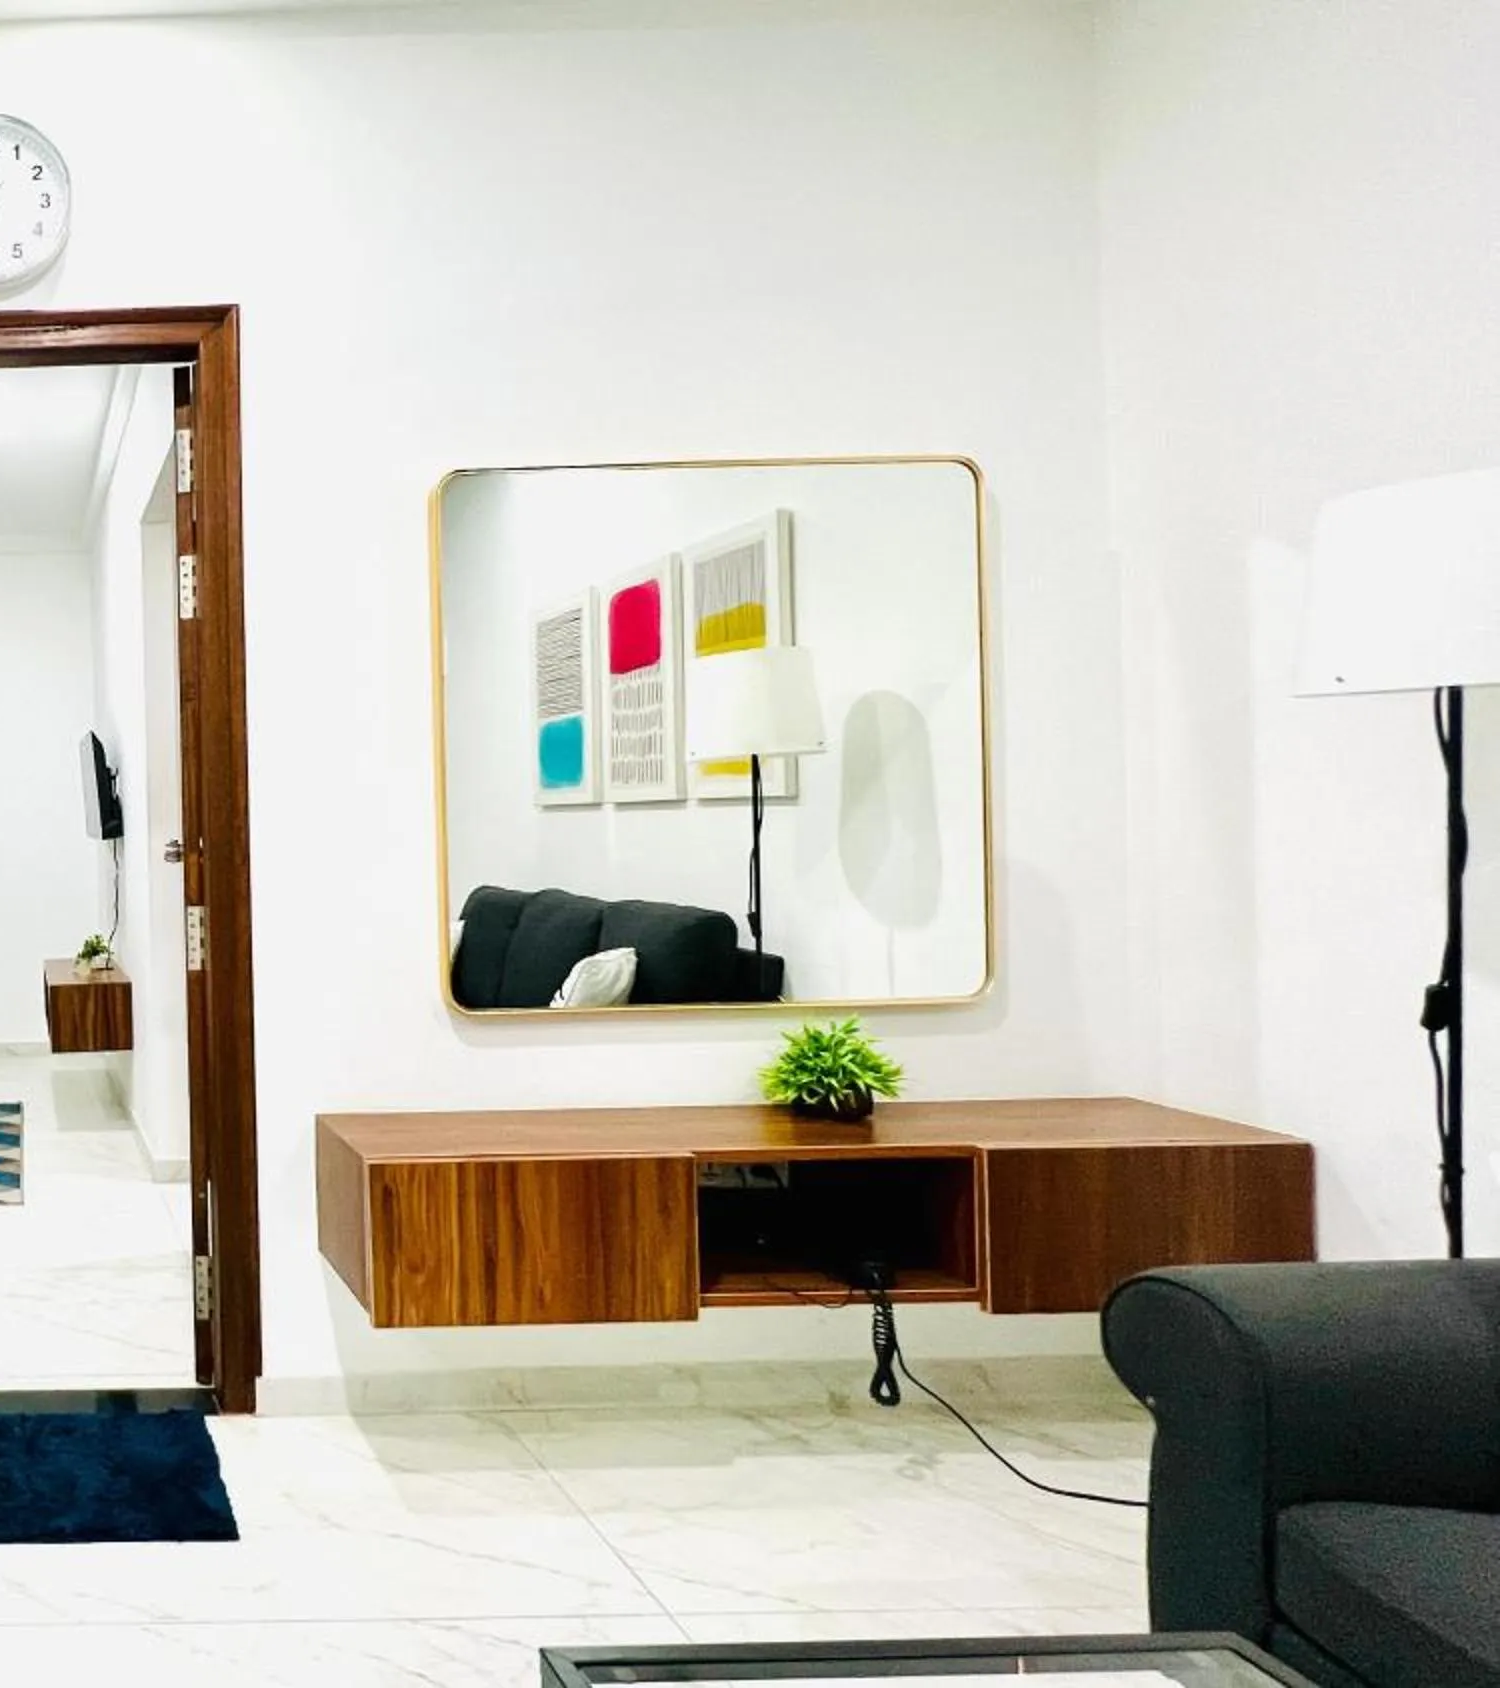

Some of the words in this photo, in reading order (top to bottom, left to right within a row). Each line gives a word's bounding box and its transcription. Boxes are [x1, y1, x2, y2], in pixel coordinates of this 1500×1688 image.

[13, 144, 20, 160] 1
[31, 165, 43, 181] 2
[40, 193, 51, 208] 3
[33, 221, 43, 236] 4
[12, 243, 23, 259] 5
